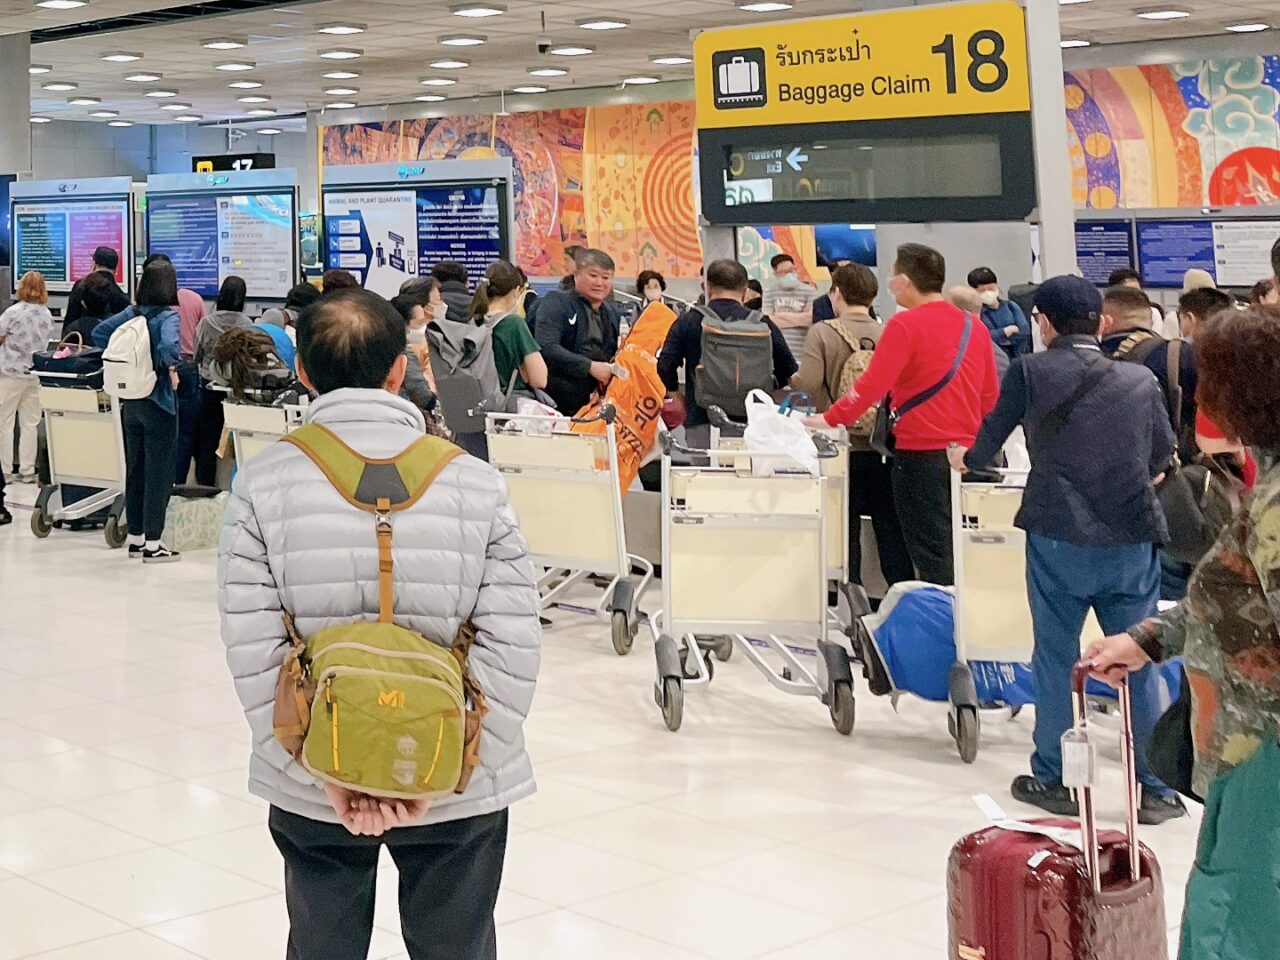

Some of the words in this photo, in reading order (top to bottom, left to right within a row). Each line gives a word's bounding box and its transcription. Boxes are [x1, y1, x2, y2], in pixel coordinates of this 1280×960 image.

[775, 28, 871, 67] รับกระเป๋า
[931, 29, 1009, 95] 18
[778, 82, 865, 105] Baggage
[871, 75, 931, 95] Claim
[231, 159, 253, 171] 17
